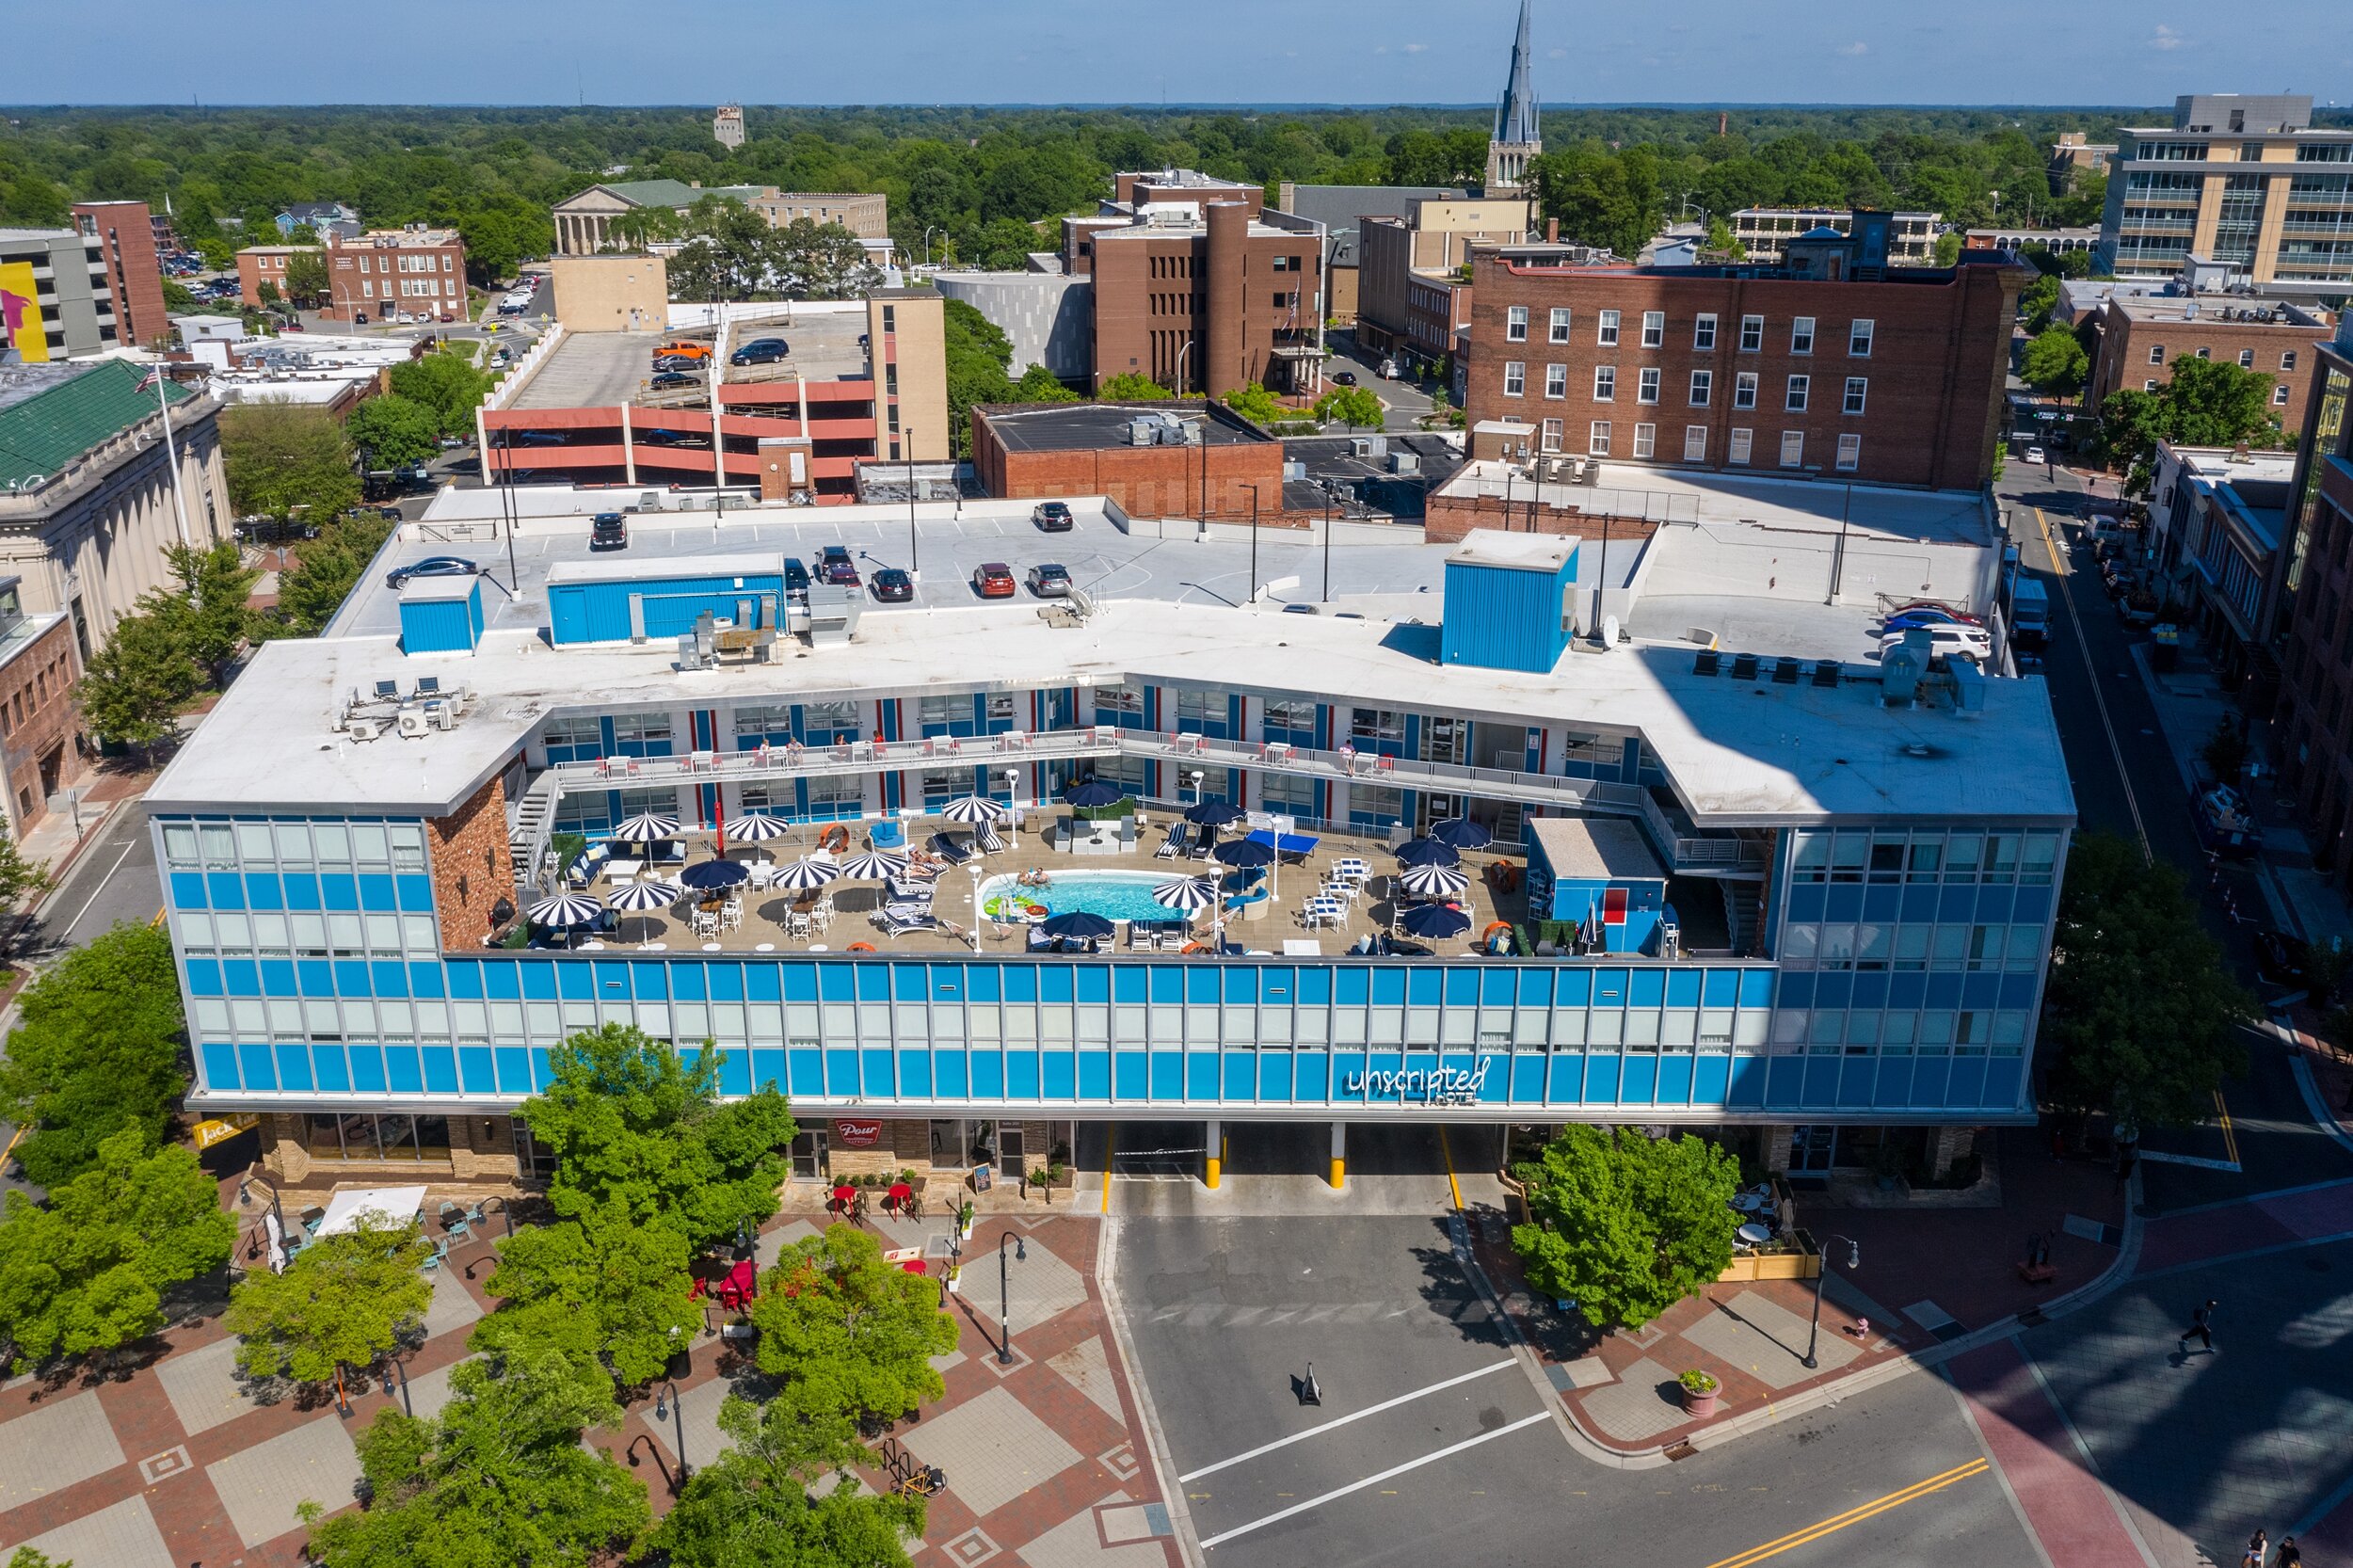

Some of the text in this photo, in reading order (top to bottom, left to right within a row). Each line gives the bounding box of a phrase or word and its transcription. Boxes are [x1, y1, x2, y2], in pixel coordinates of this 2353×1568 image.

[1348, 1055, 1491, 1104] unscripted
[1435, 1092, 1481, 1105] HOTEL
[201, 1119, 234, 1145] Jack
[839, 1123, 877, 1136] Pour
